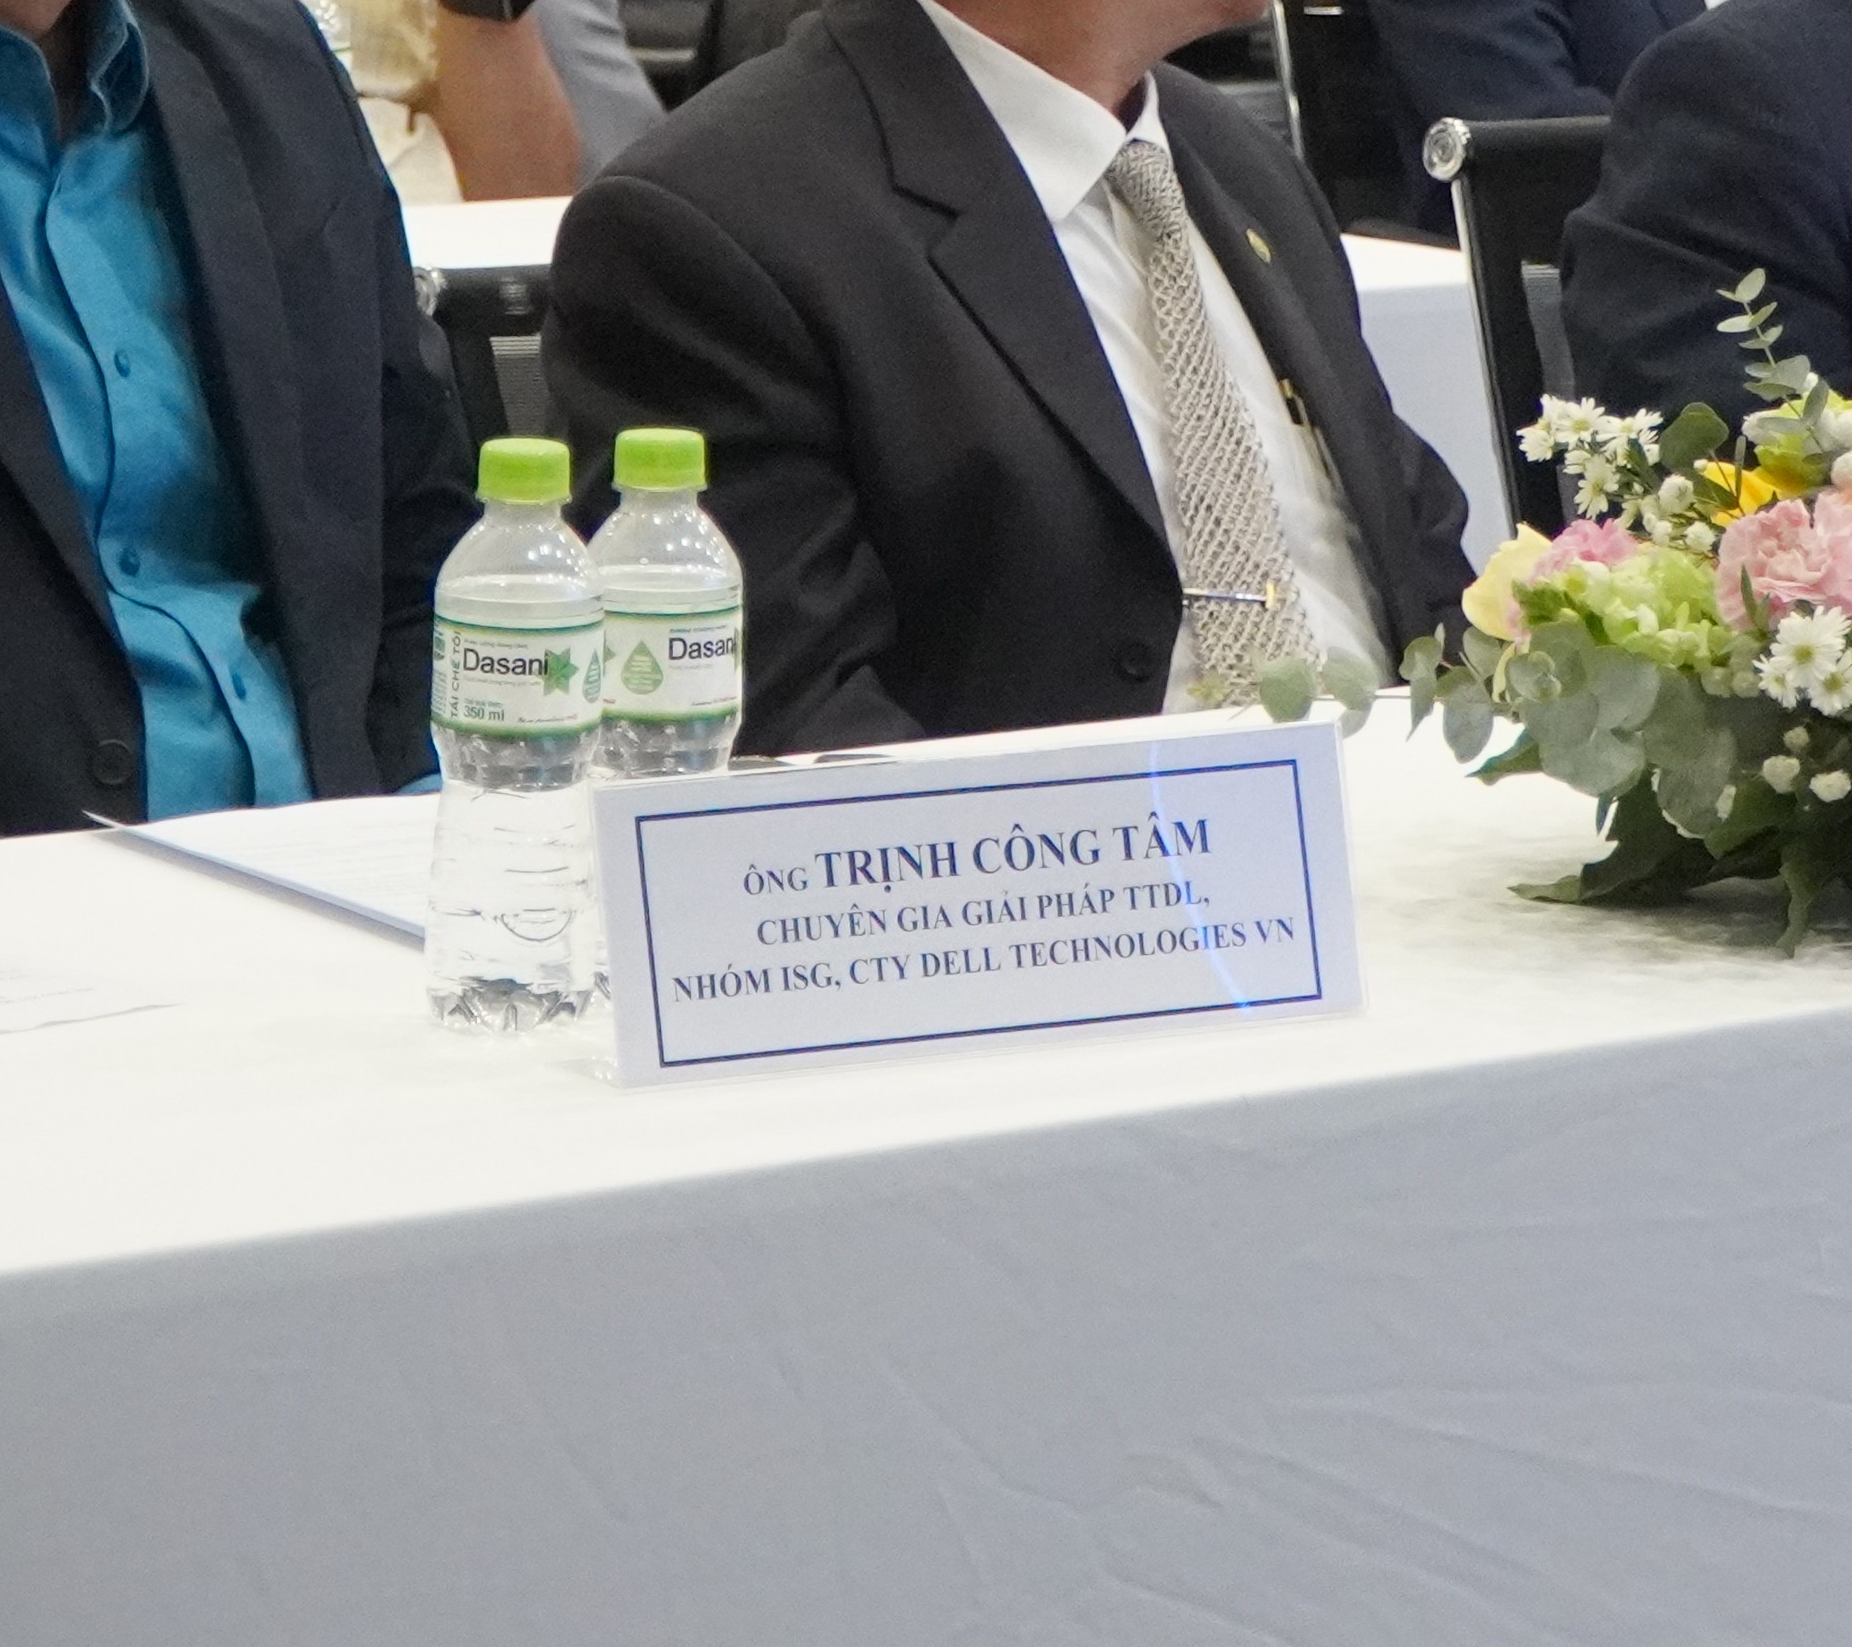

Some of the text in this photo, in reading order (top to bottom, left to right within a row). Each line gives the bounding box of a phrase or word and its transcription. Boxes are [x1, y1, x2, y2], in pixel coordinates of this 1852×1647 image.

[463, 647, 548, 676] Dasani
[463, 705, 485, 720] 350
[488, 709, 504, 721] ml
[743, 811, 1211, 895] ÔNG TRỊNH CÔNG TÂM
[756, 880, 1210, 946] CHUYÊN GIA GIẢI PHÁP TTDL,
[672, 917, 1295, 1002] NHÓM ISG, CTY DELL TECHNOLOGIES VN
